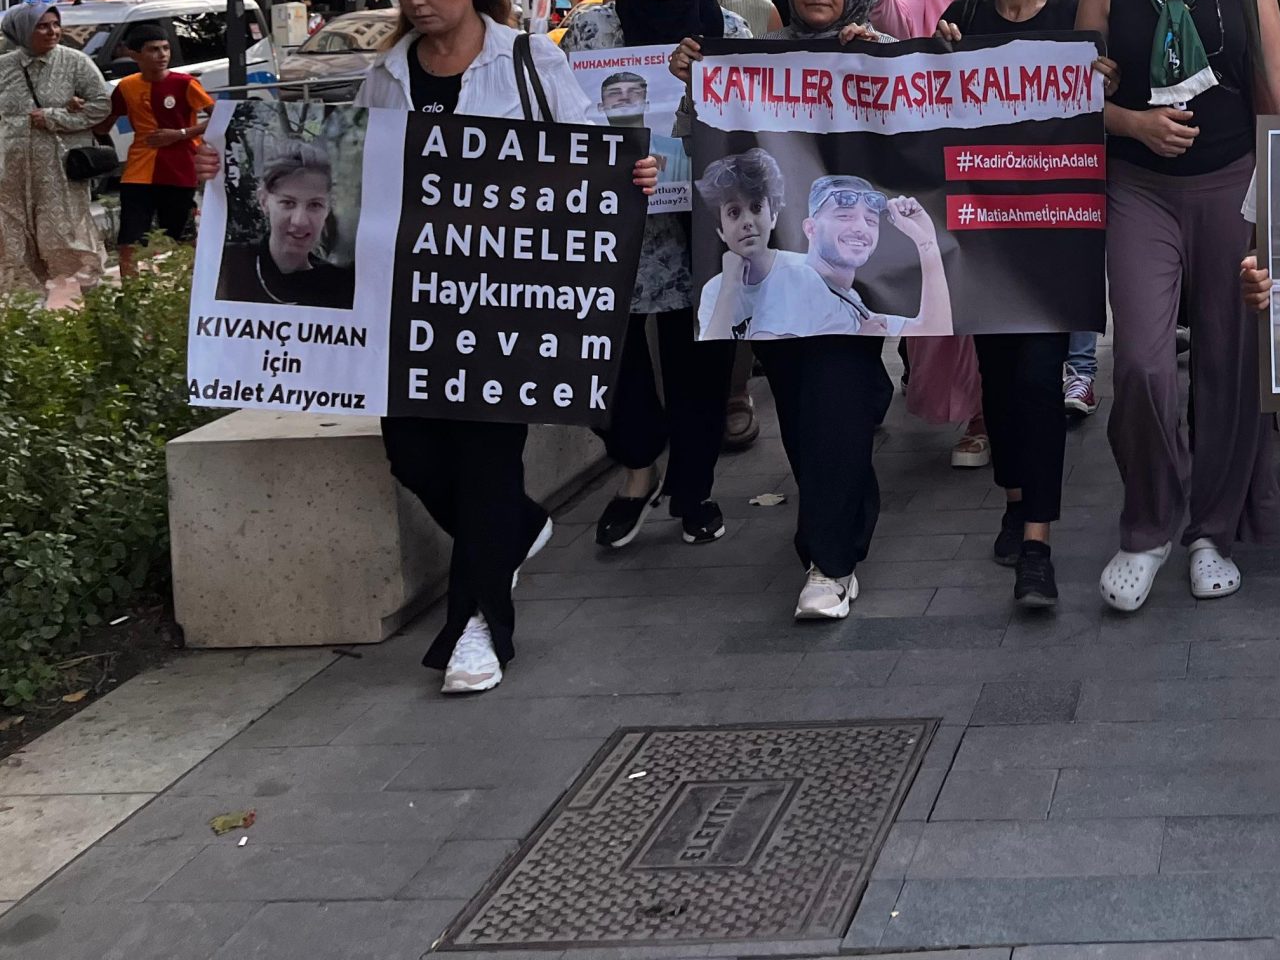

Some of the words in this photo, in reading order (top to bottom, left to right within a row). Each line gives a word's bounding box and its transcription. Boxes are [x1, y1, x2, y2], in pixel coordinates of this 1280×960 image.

[573, 54, 642, 71] MUHAMMETİN
[644, 53, 665, 65] SESİ
[842, 70, 953, 120] CEZASIZ
[959, 64, 1094, 114] KALMASIN
[422, 125, 624, 167] ADALET
[421, 174, 618, 215] Sussada
[412, 222, 617, 263] ANNELER
[411, 271, 616, 319] Haykırmaya
[196, 316, 292, 347] KIVANÇ
[298, 323, 367, 348] UMAN
[409, 320, 612, 361] Devam
[262, 351, 302, 376] için
[187, 378, 265, 404] Adalet
[268, 388, 365, 411] Arıyoruz
[408, 368, 607, 411] Edecek
